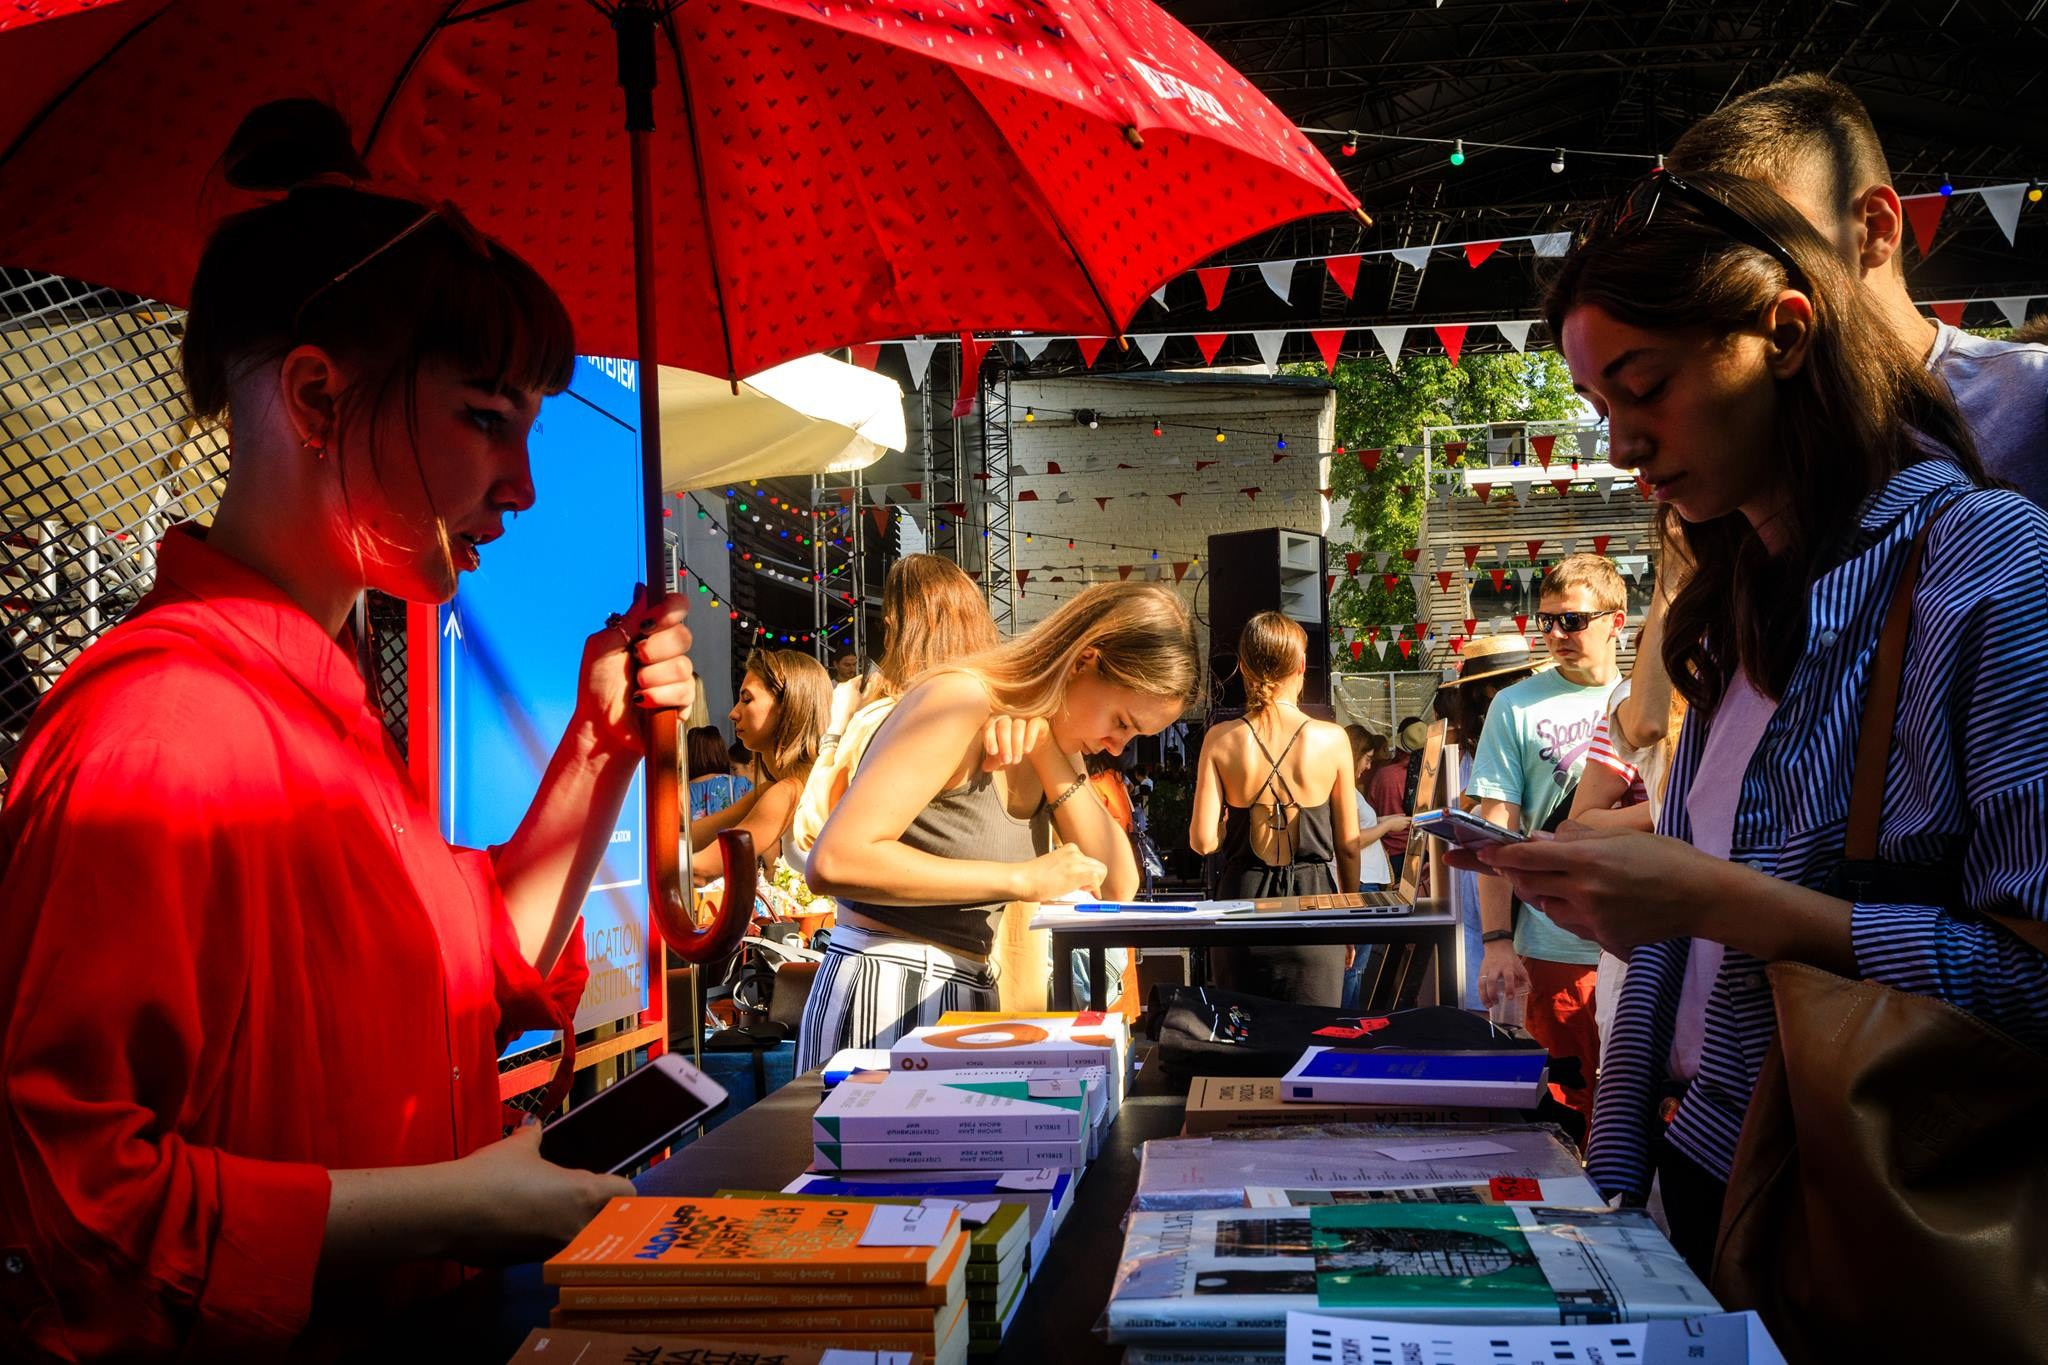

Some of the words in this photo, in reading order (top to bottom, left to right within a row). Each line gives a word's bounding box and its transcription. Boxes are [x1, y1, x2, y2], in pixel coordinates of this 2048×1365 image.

[586, 922, 641, 963] UCATION
[1038, 1152, 1063, 1160] STRELKA
[634, 1204, 703, 1259] АДОЛЬФ
[674, 1215, 728, 1250] ЛООС
